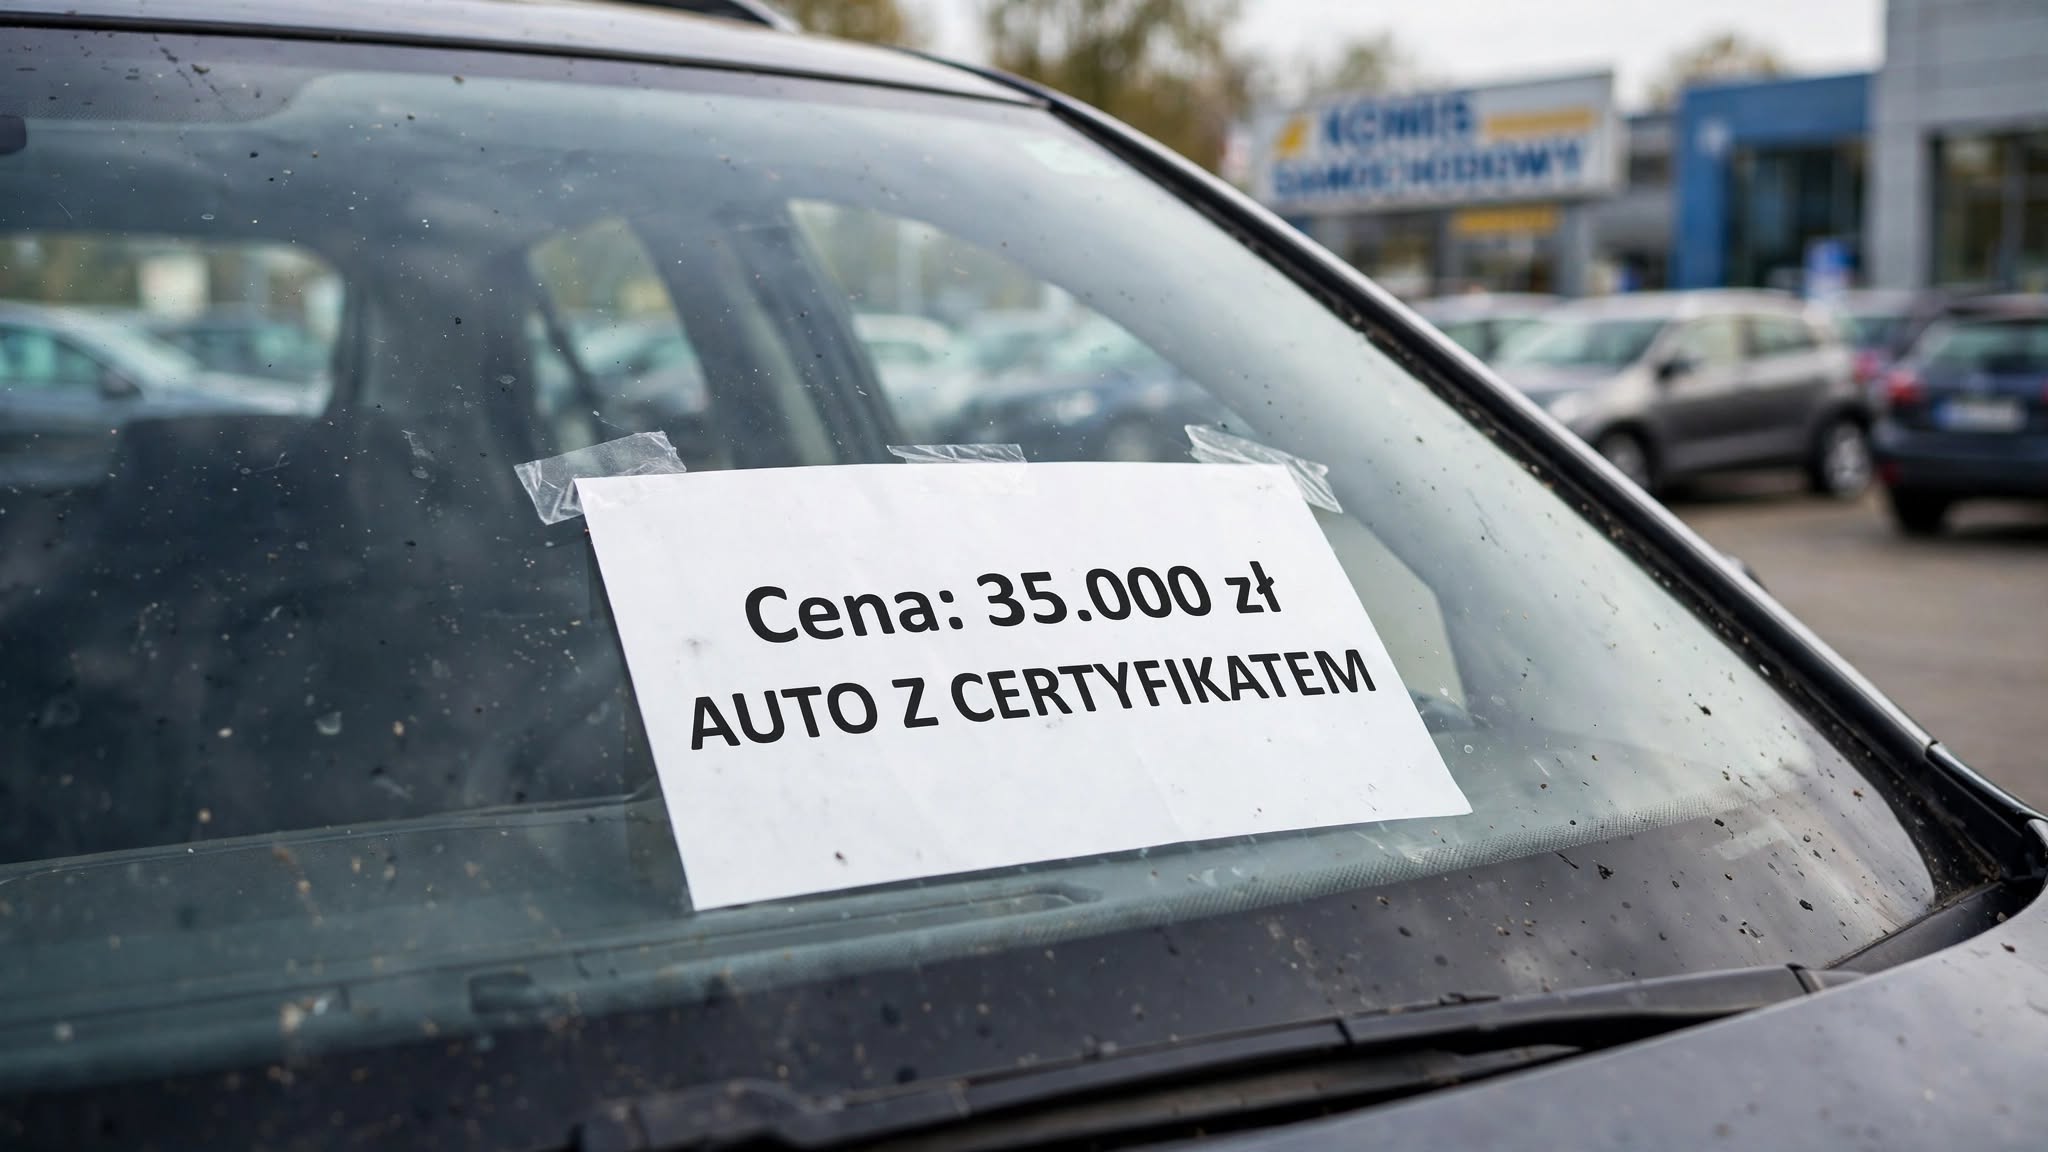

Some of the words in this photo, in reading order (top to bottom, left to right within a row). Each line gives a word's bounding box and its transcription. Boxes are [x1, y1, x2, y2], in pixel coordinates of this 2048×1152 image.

[745, 585, 964, 644] Cena:
[976, 565, 1212, 627] 35.000
[1224, 560, 1282, 614] zł
[691, 682, 878, 751] AUTO
[891, 677, 939, 729] Z
[950, 649, 1377, 723] CERTYFIKATEM
